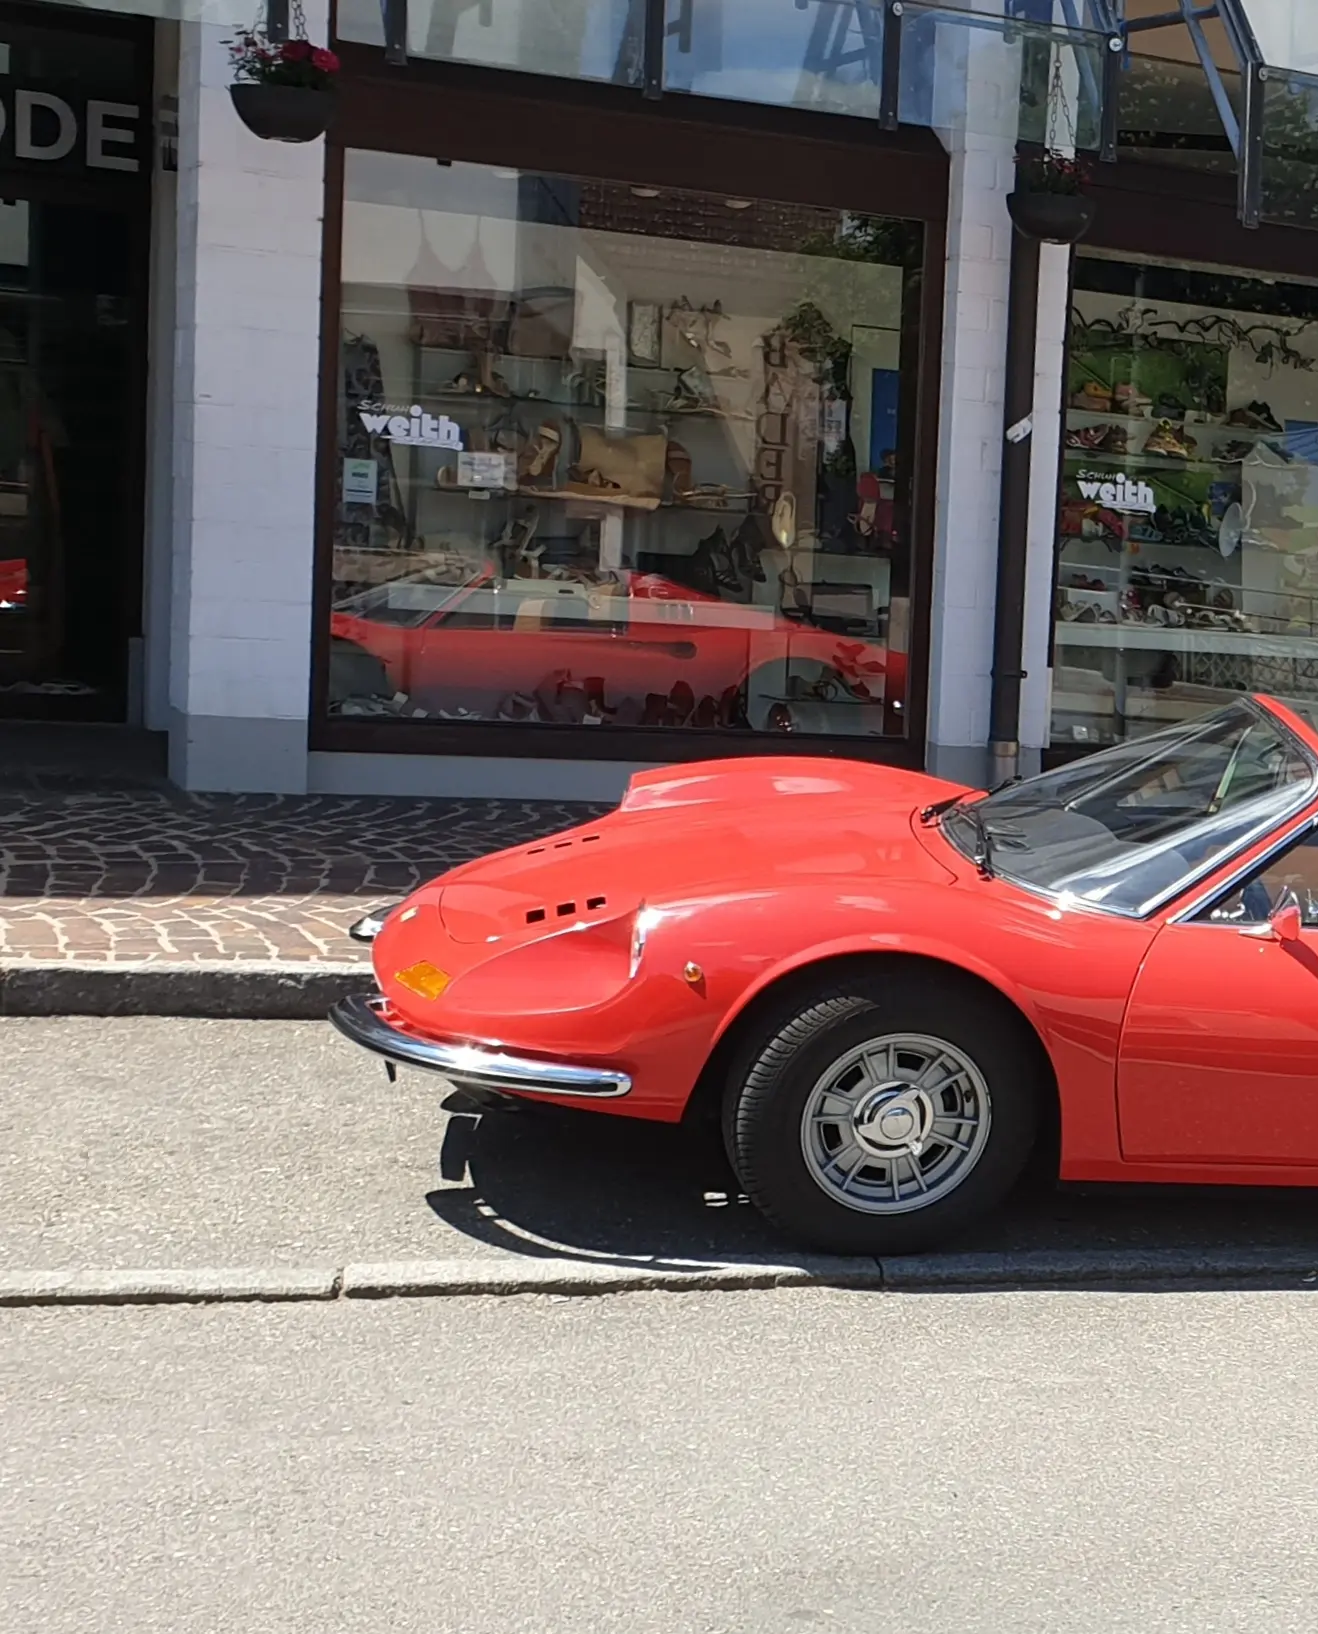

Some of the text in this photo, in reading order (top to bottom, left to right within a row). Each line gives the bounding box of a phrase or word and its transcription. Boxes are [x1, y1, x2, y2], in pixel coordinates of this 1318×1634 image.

[0, 88, 139, 172] DE
[359, 405, 461, 441] weith
[1077, 473, 1154, 505] weith
